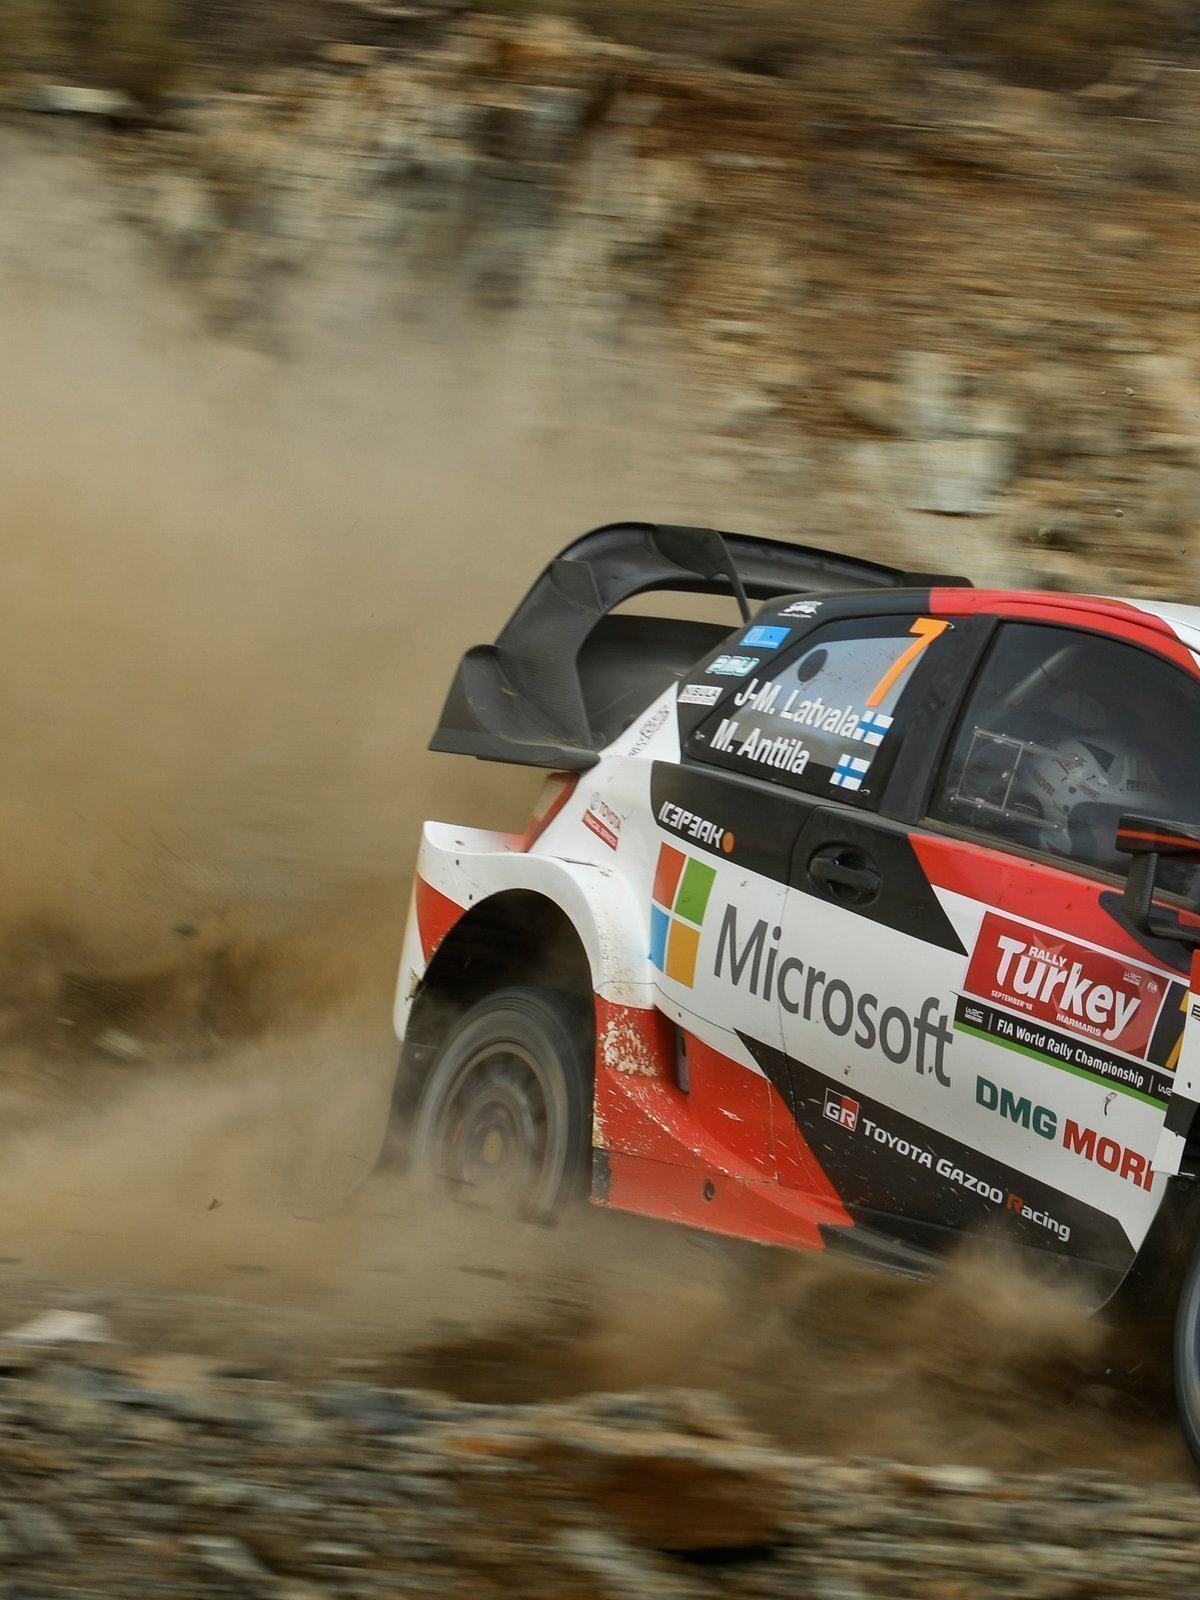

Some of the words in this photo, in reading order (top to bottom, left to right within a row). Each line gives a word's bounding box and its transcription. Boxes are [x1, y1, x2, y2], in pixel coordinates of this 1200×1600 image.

[866, 617, 950, 707] 7
[709, 718, 740, 753] M.
[736, 728, 810, 775] Anttila
[734, 678, 783, 715] J-M.
[779, 689, 861, 740] Latvala
[713, 904, 954, 1087] Microsoft
[996, 935, 1141, 1041] Turkey
[1029, 946, 1067, 967] RALLY
[996, 1019, 1013, 1036] FIA
[1016, 1025, 1046, 1047] World
[1047, 1038, 1074, 1061] Rally
[1074, 1049, 1144, 1088] Championship
[1056, 1013, 1102, 1036] MARMARIS
[825, 1101, 856, 1130] GR
[863, 1118, 933, 1168] TOYOTA
[935, 1158, 1003, 1204] GAZOO
[1006, 1193, 1071, 1242] Racing
[976, 1075, 1057, 1141] DMG
[1063, 1119, 1155, 1192] MORI
